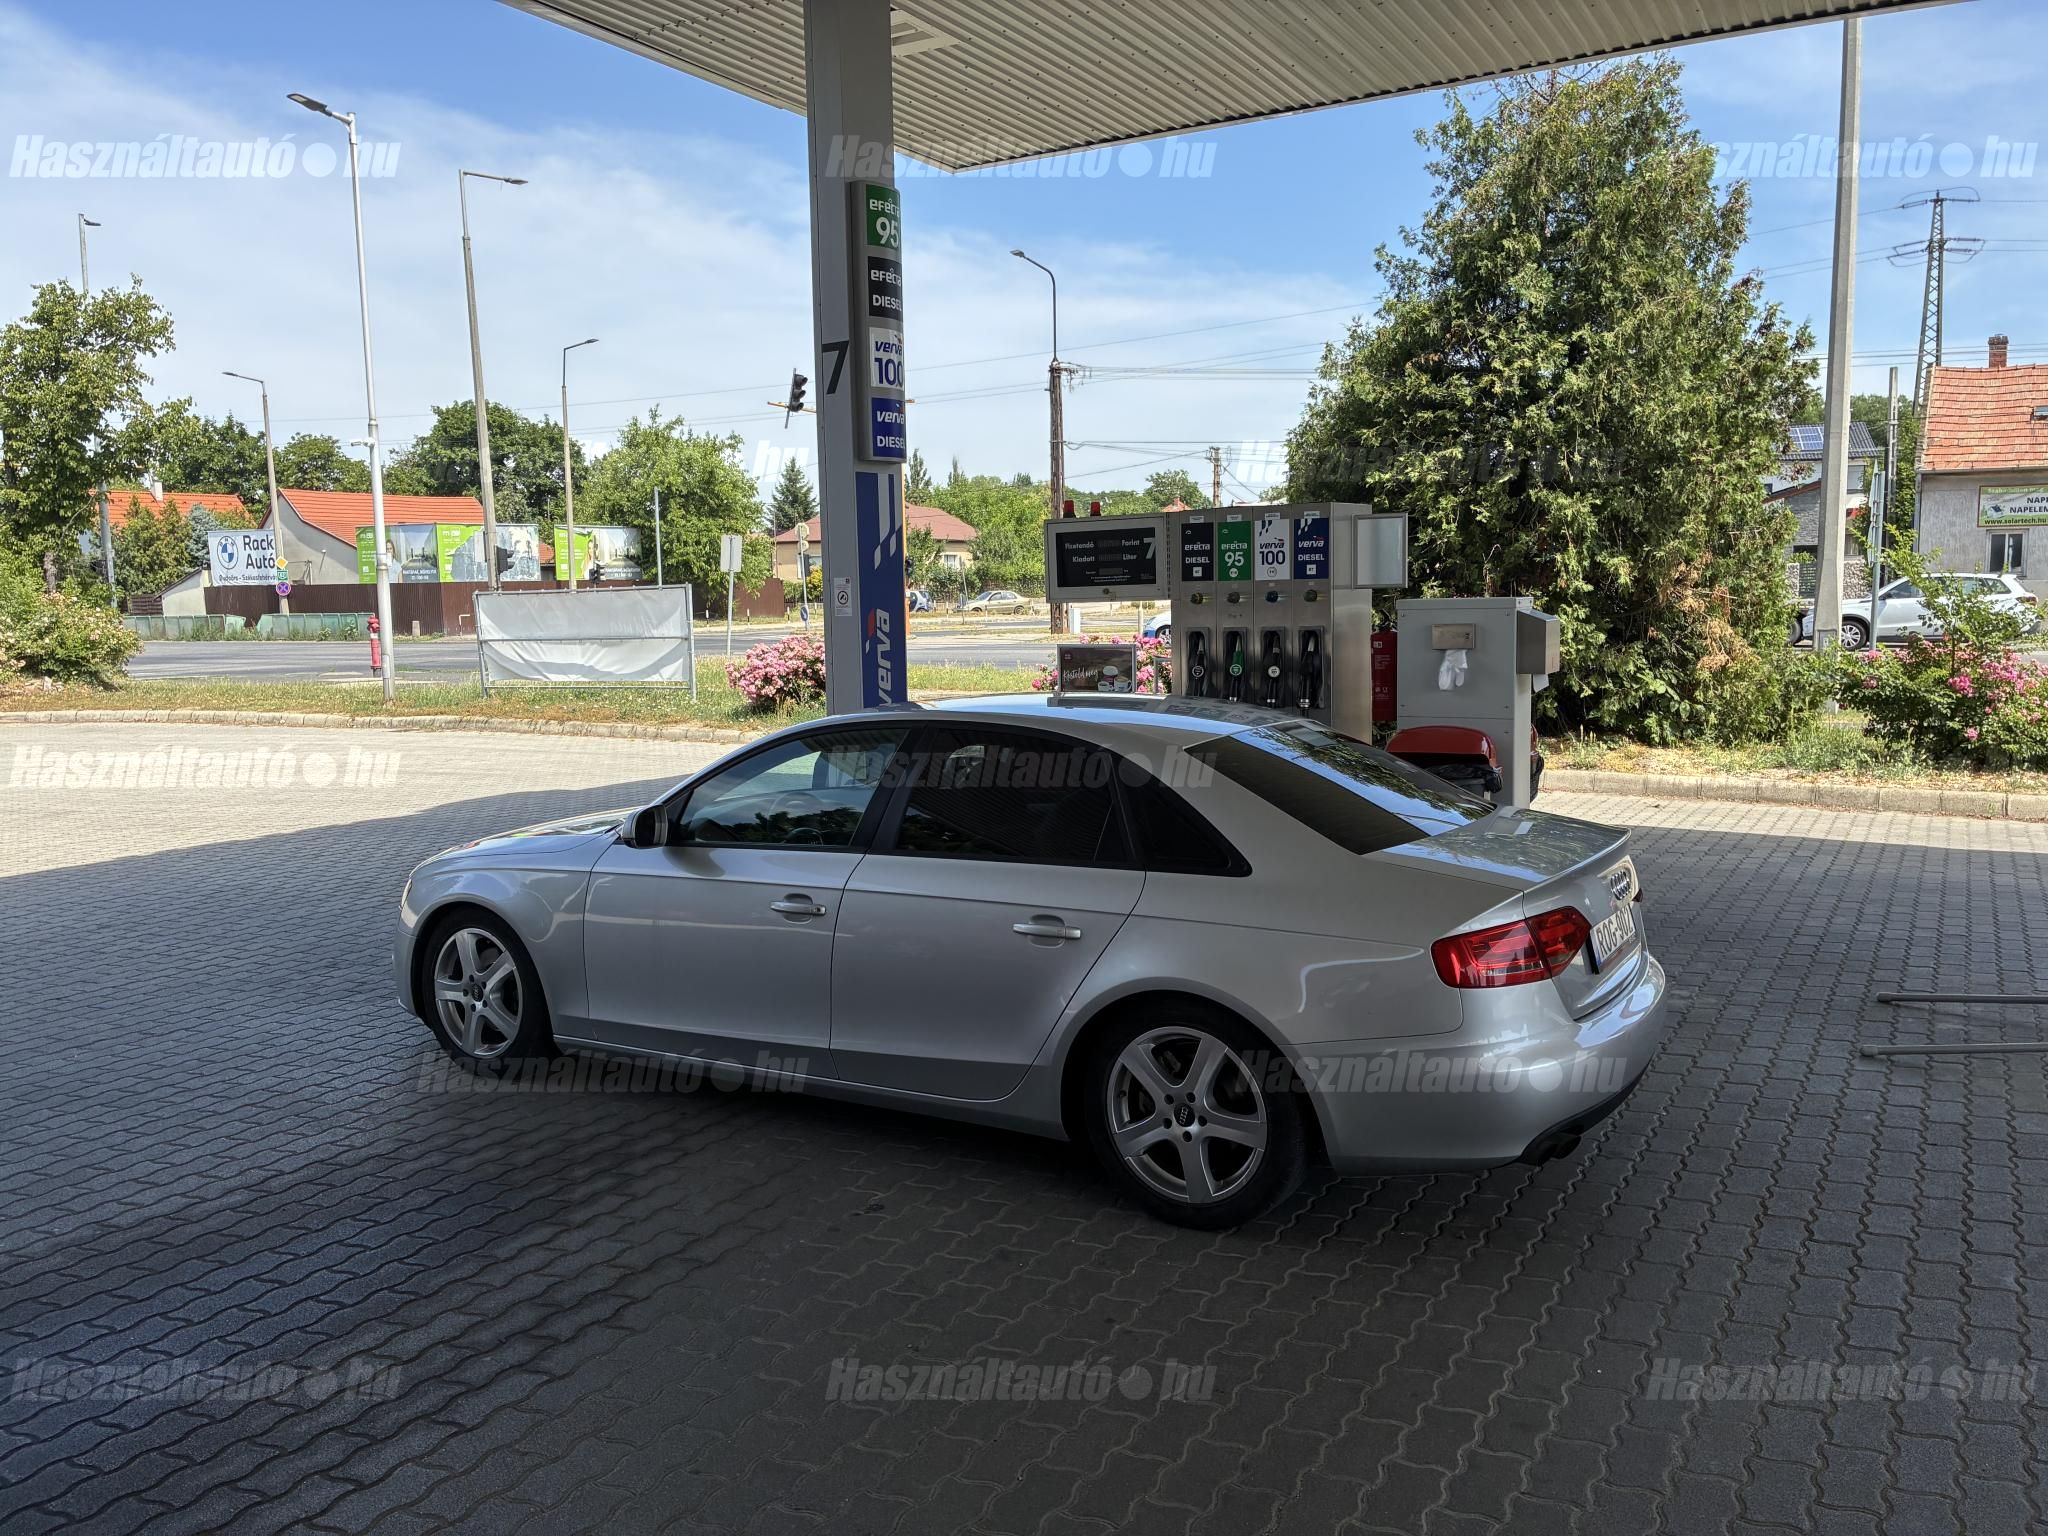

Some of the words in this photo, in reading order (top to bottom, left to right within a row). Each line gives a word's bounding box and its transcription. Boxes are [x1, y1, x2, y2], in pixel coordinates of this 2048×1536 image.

[875, 216, 900, 248] 95
[822, 340, 849, 395] 7
[874, 357, 904, 388] 100
[876, 410, 905, 425] verva
[876, 435, 906, 449] DIESE
[2026, 496, 2048, 504] NAP
[242, 534, 275, 551] Rack
[1143, 537, 1156, 560] 7
[1259, 542, 1285, 550] verva
[1298, 540, 1325, 548] verva
[245, 553, 276, 570] Autó
[1185, 556, 1211, 564] DIESEL
[1224, 551, 1245, 567] 95
[1259, 550, 1286, 566] 100
[1297, 553, 1325, 561] DIESEL
[1595, 907, 1634, 958] ROG-902
